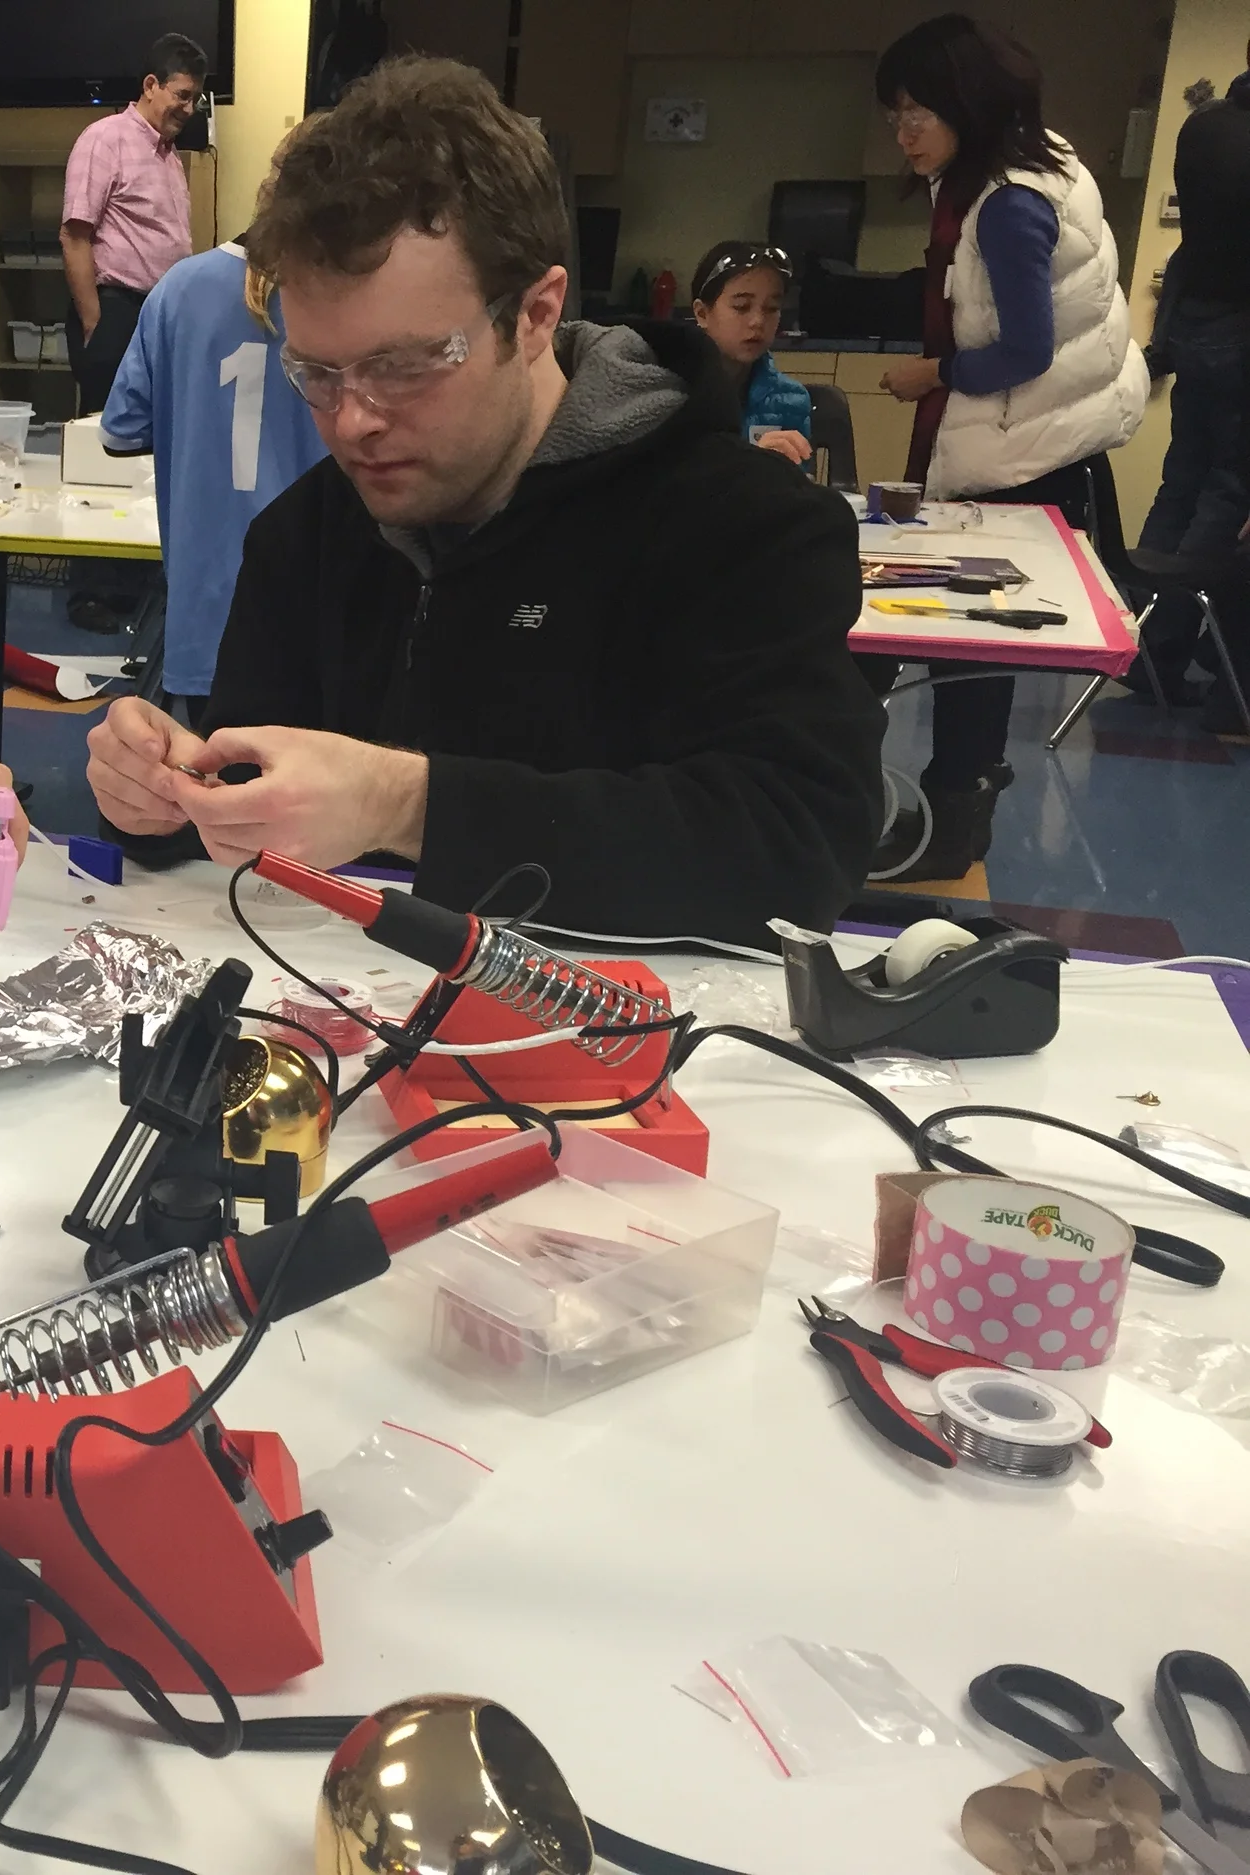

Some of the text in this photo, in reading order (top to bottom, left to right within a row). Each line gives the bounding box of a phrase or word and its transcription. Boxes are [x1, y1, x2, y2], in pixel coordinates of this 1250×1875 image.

[220, 341, 268, 491] 1
[1033, 1208, 1060, 1216] DUCK
[1053, 1223, 1095, 1252] DUCK
